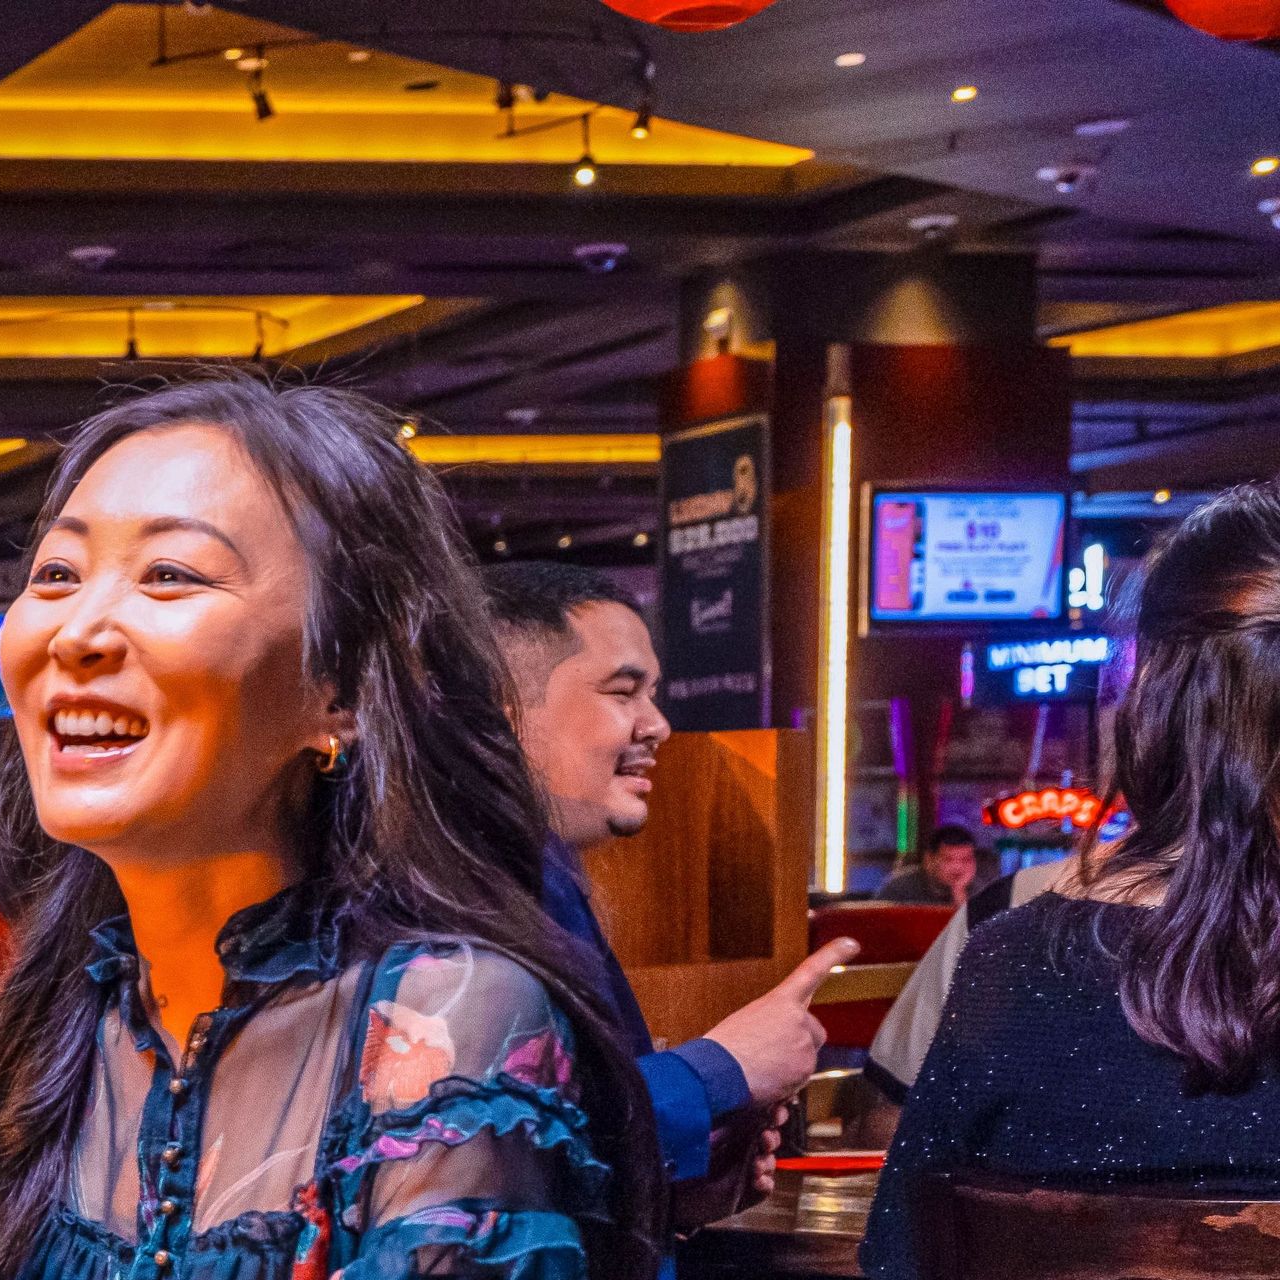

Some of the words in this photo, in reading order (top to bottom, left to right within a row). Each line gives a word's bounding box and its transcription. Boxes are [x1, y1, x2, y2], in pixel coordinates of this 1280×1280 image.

[990, 637, 1108, 667] MINIMUM
[1017, 664, 1072, 693] BET
[1000, 789, 1099, 827] CRAPS
